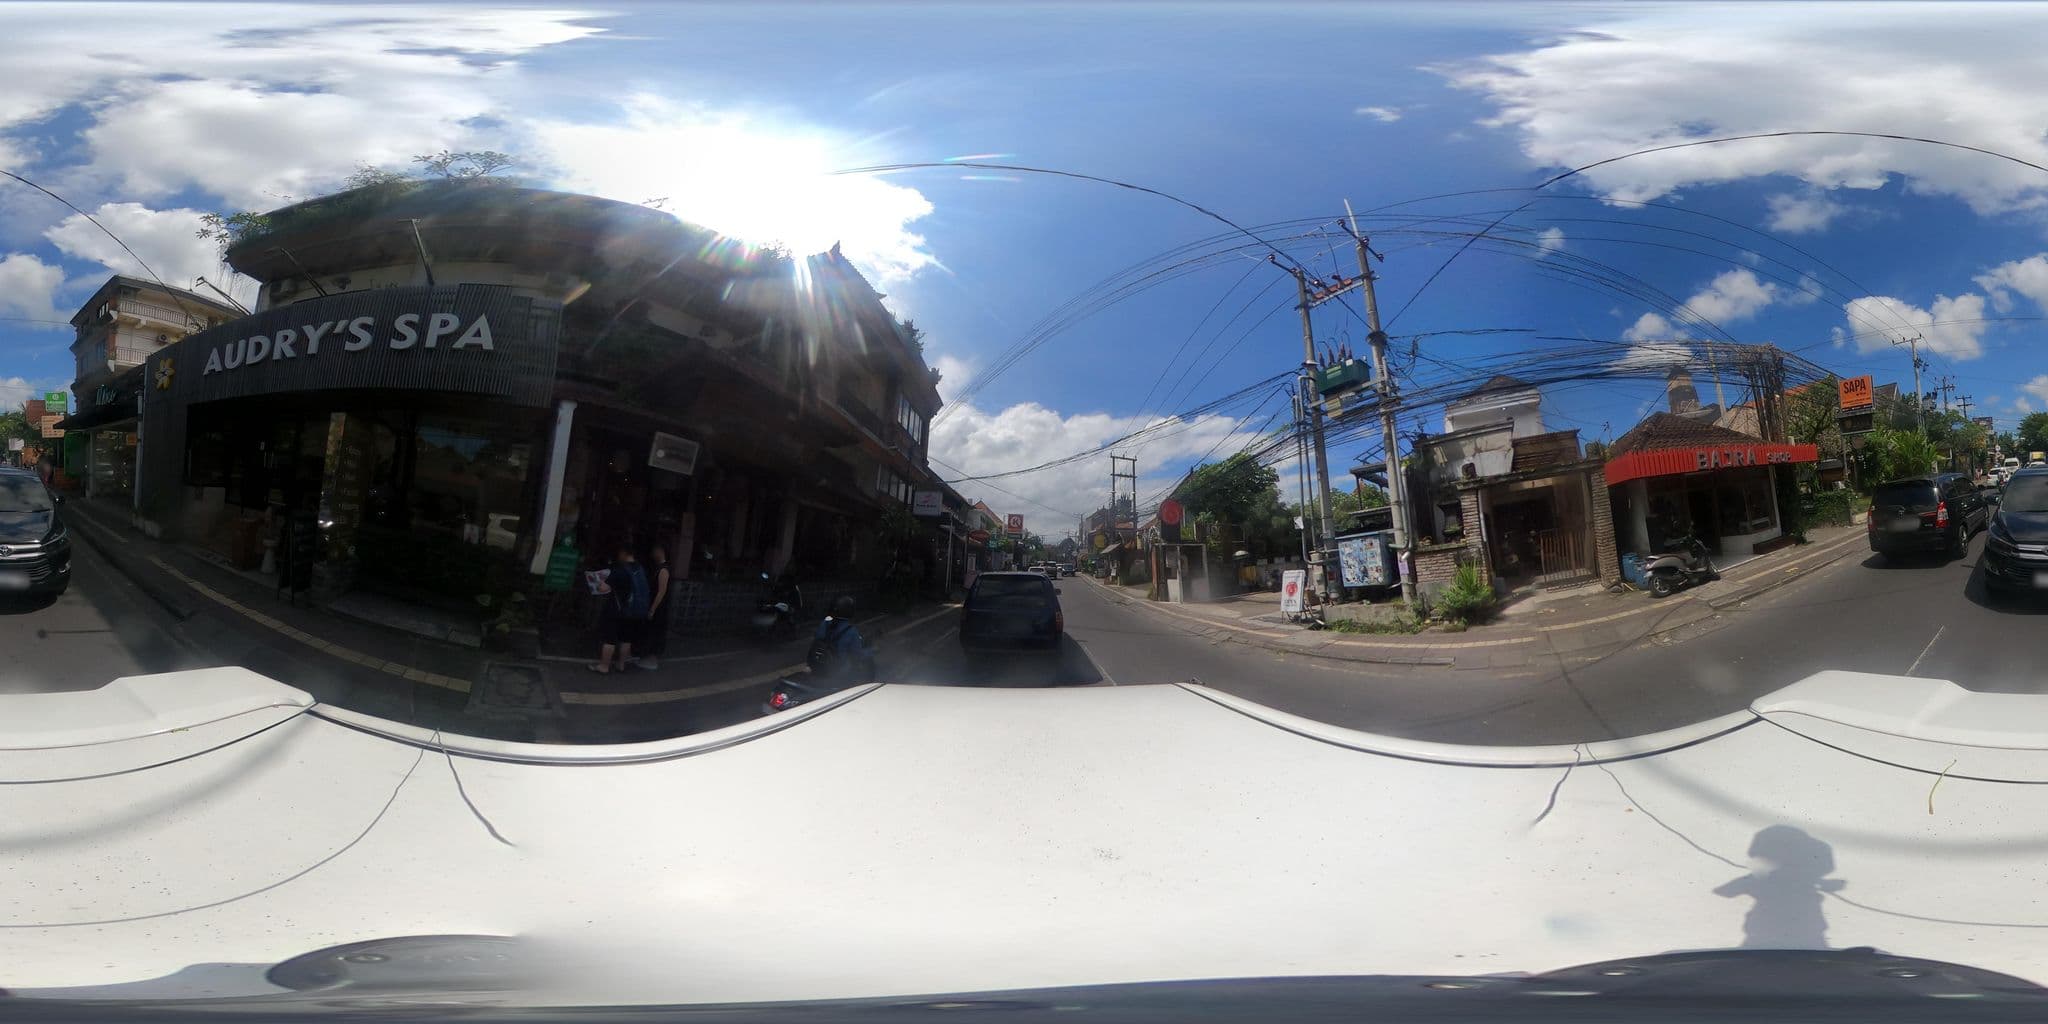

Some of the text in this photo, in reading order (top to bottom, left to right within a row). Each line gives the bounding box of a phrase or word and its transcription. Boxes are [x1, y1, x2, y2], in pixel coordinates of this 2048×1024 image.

[203, 313, 494, 376] AUDRY'S SPA
[1843, 378, 1866, 394] SAPA
[1767, 452, 1791, 464] SHOP
